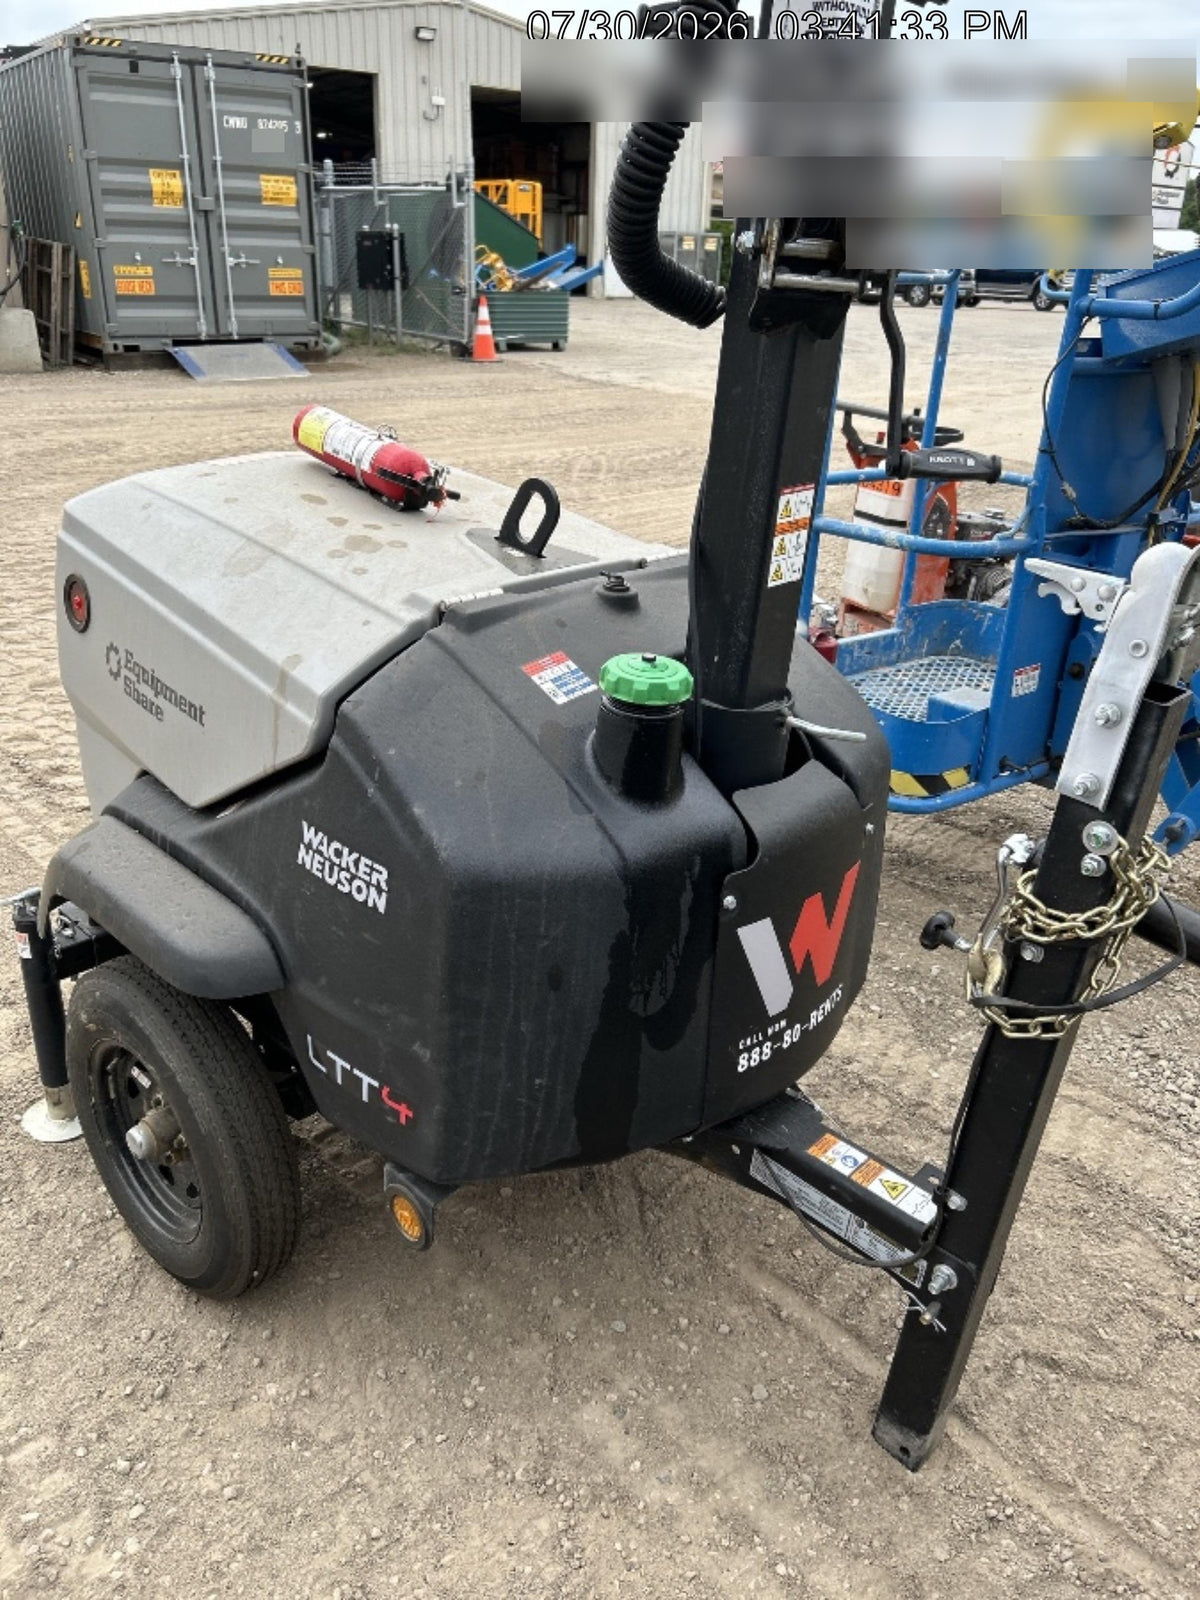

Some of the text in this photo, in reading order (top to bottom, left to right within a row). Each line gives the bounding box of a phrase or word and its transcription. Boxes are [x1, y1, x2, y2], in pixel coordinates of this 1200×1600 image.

[123, 648, 206, 728] Equipment
[123, 674, 164, 722] Share
[297, 843, 388, 914] NEUSON
[301, 819, 388, 892] WACKER
[739, 1032, 763, 1050] CALL
[307, 1034, 413, 1126] LTT4
